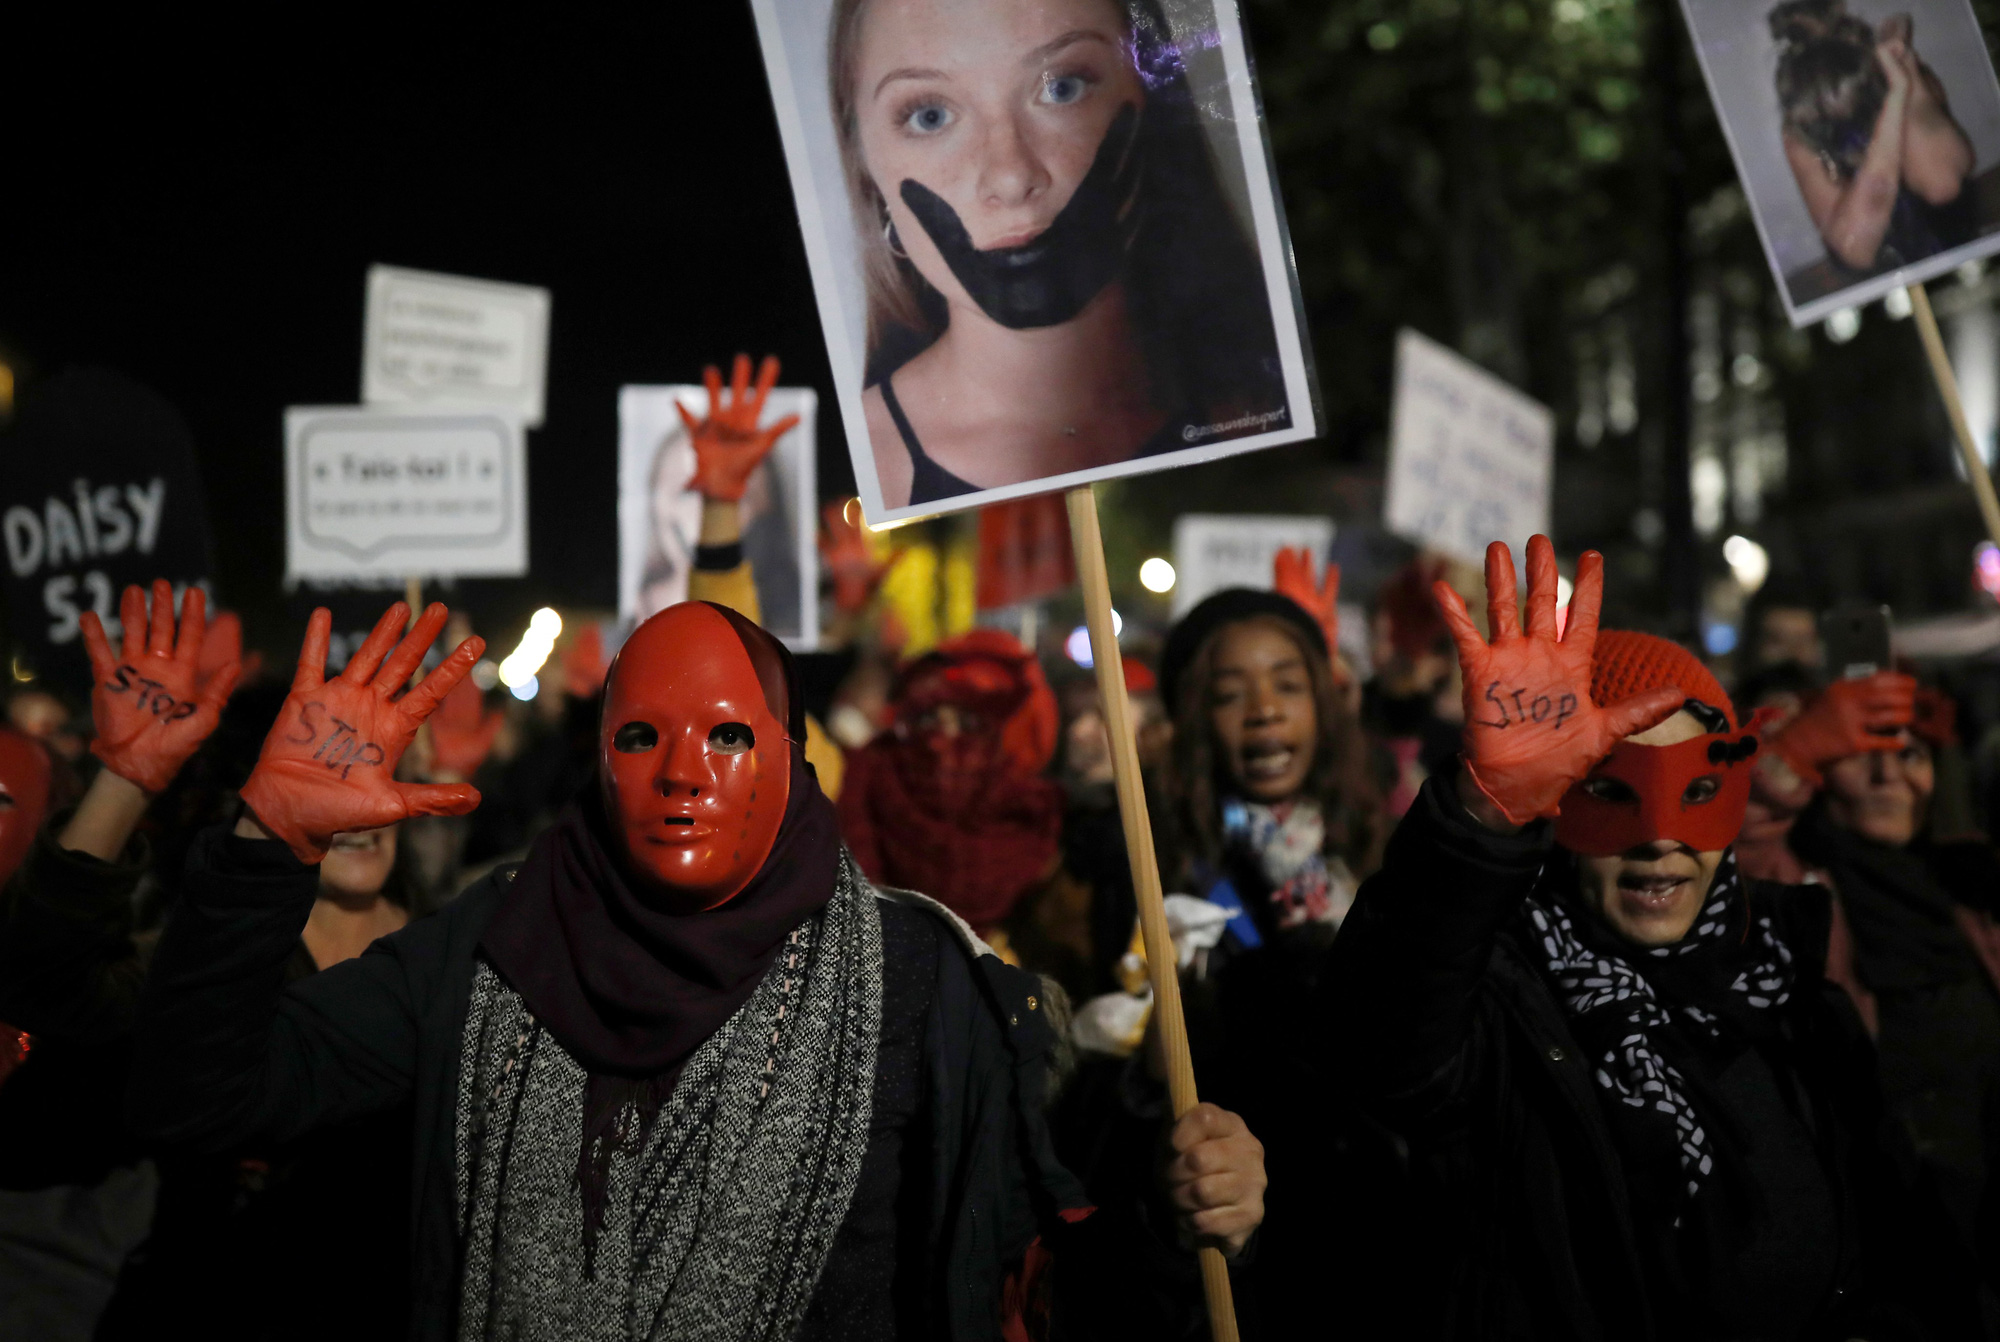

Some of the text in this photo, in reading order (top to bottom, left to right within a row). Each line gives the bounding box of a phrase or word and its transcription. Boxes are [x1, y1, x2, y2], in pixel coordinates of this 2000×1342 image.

[105, 664, 198, 725] STOP
[1474, 680, 1578, 730] STOP
[286, 701, 385, 780] STOP
